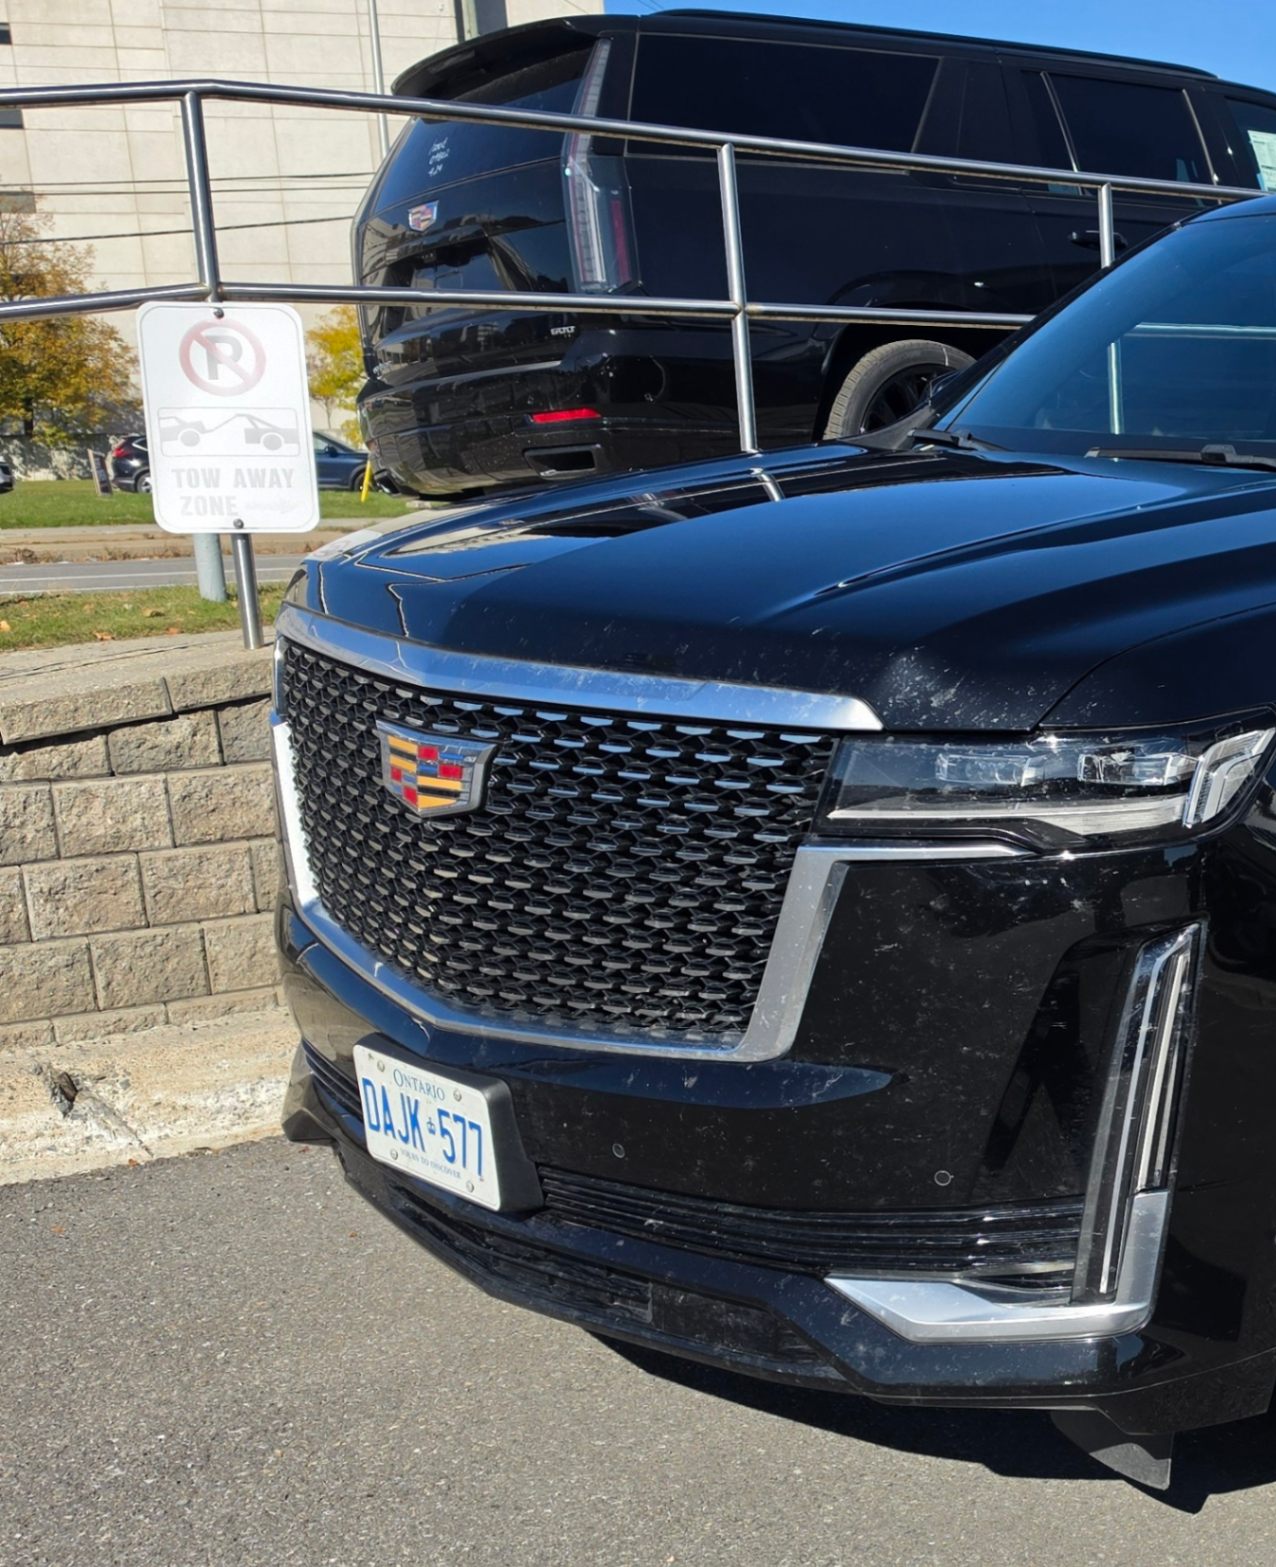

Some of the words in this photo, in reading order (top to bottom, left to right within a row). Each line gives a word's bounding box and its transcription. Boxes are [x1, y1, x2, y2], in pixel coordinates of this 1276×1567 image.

[171, 468, 220, 488] TOW
[233, 468, 295, 488] AWAY
[180, 495, 239, 516] ZONE
[393, 1068, 445, 1101] ONTARIO
[362, 1077, 425, 1153] DAJK
[437, 1108, 483, 1177] 577
